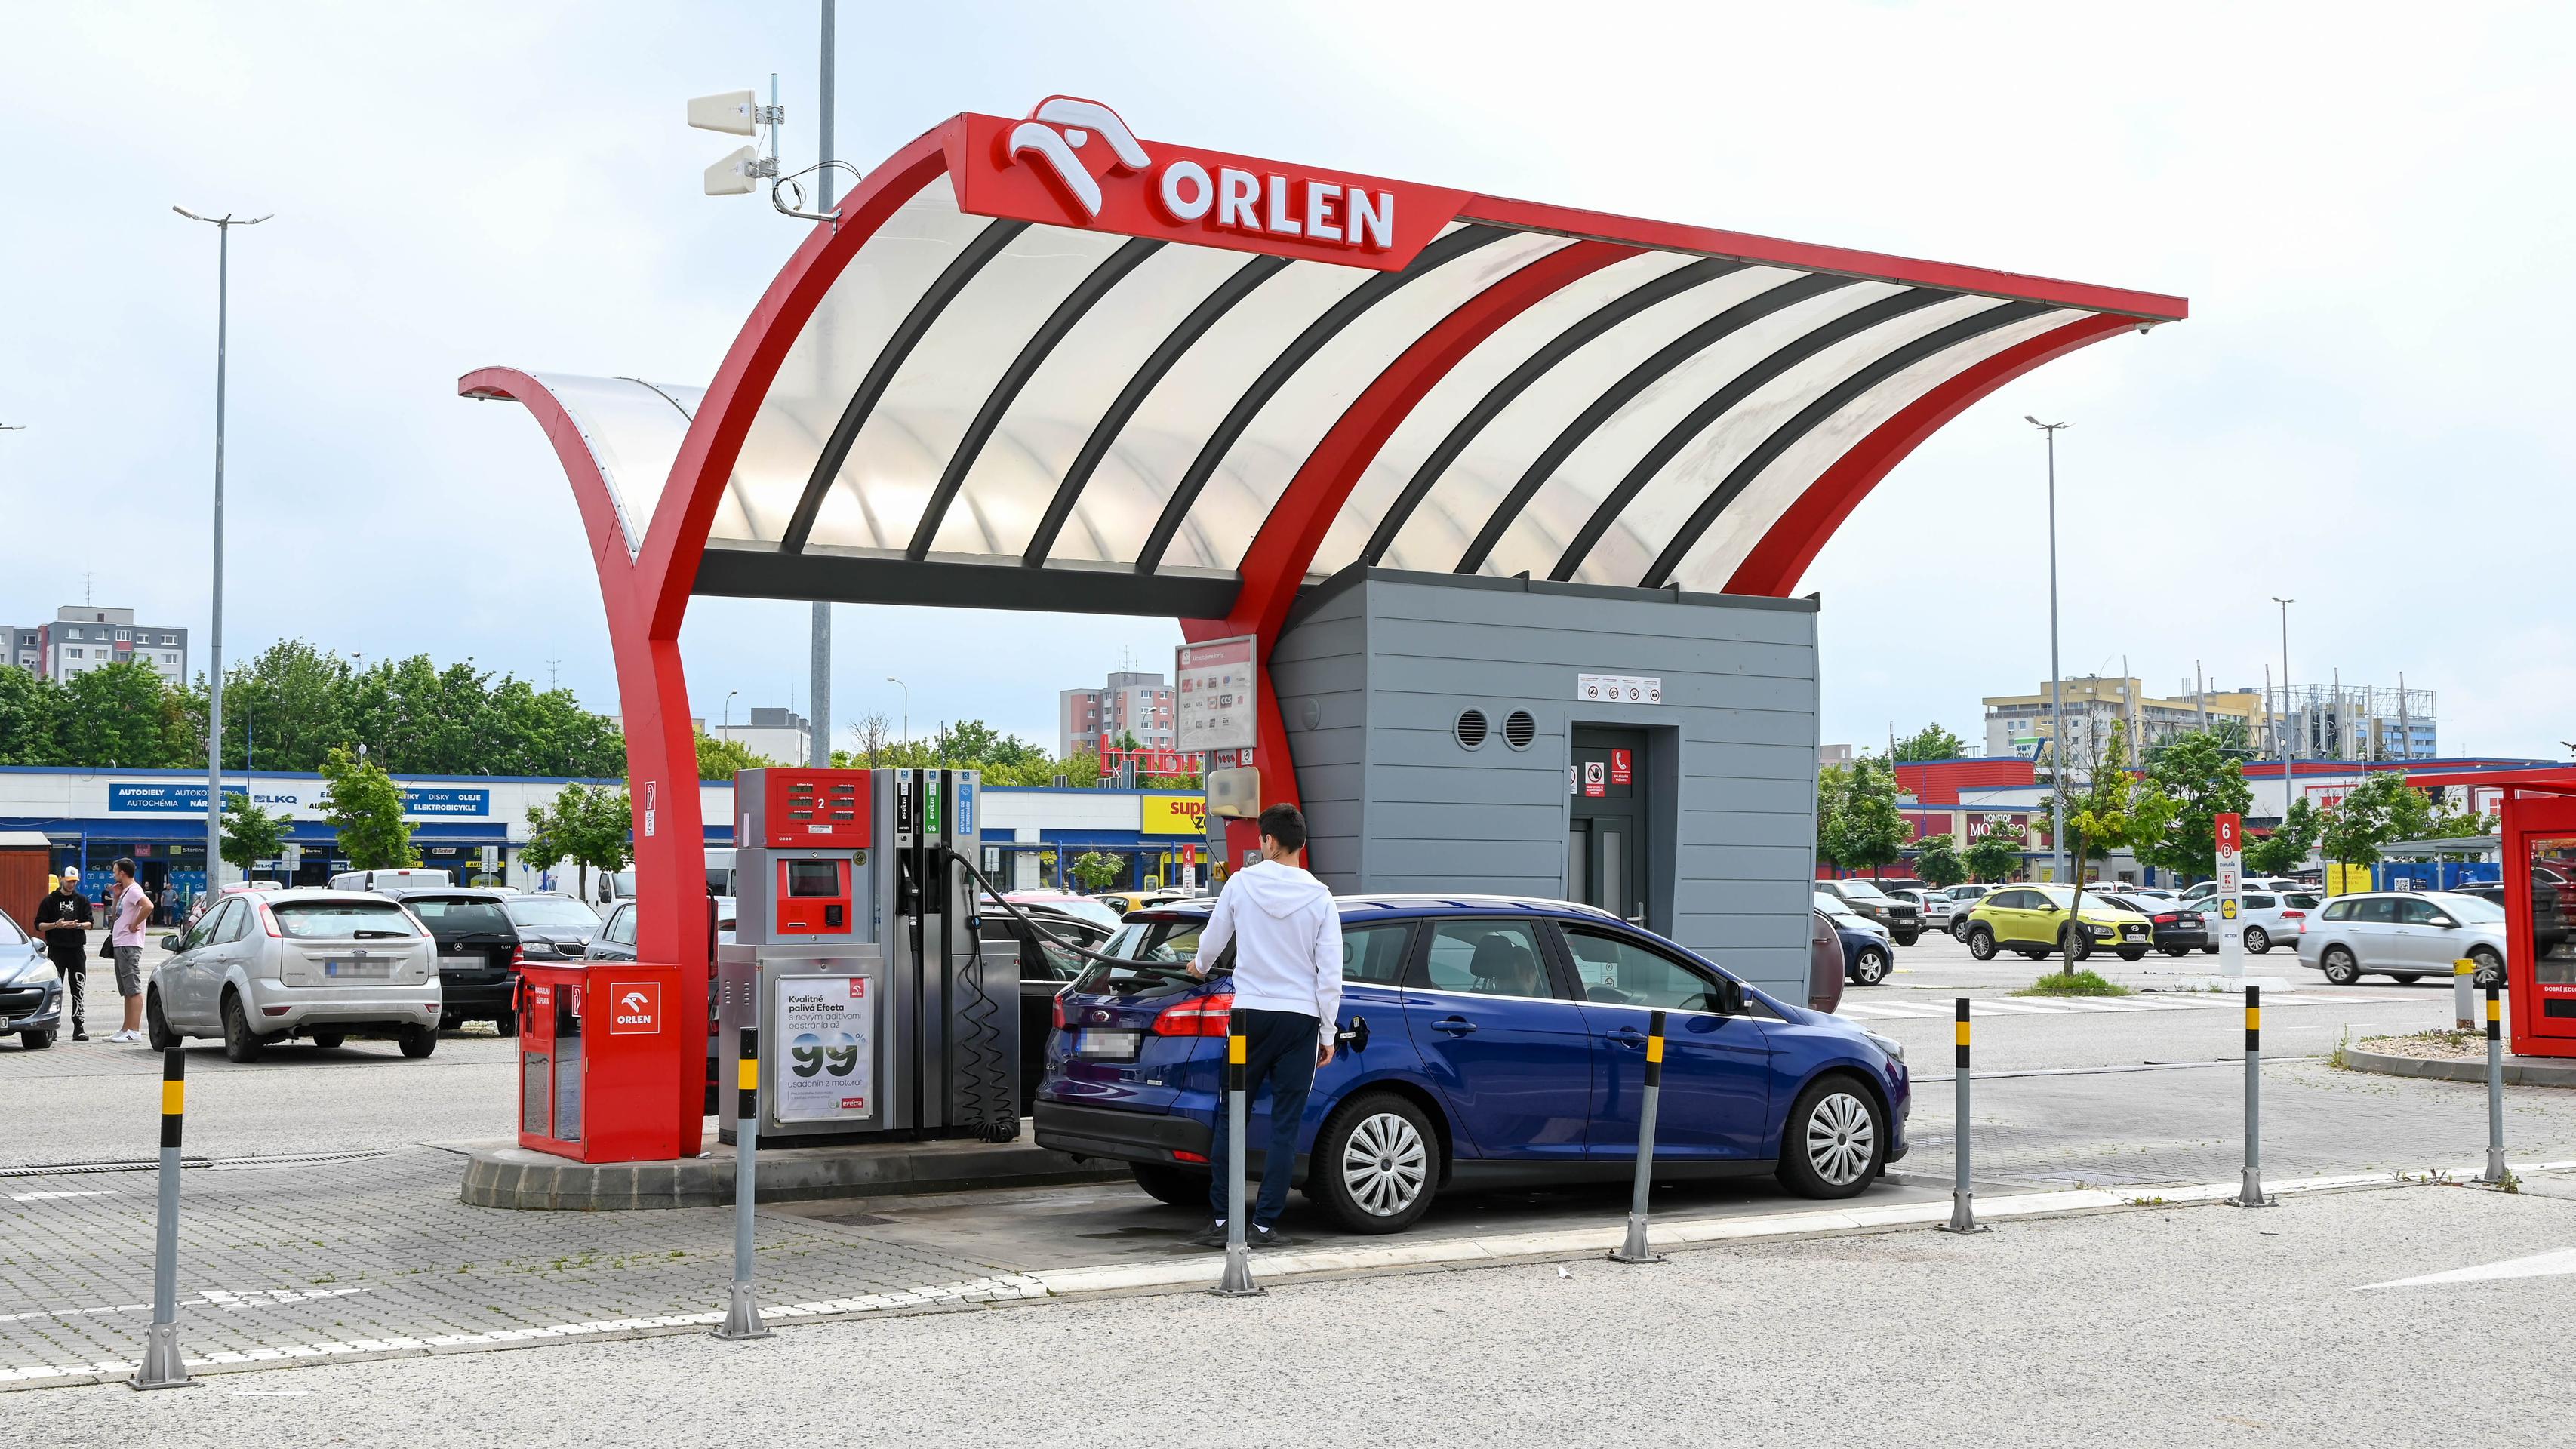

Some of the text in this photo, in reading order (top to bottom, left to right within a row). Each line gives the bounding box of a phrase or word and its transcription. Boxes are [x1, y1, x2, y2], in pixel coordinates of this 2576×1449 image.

[1160, 159, 1395, 249] ORLEN
[1220, 696, 1232, 704] CCS
[127, 798, 226, 808] AUTOCHÉMIA NÁRAIE
[266, 795, 297, 804] LKQ
[817, 798, 825, 809] 2
[1983, 814, 2012, 823] NONSTOP
[2221, 823, 2230, 840] 6
[1186, 850, 1190, 860] 4
[2224, 845, 2230, 857] B
[789, 995, 823, 1003] Kvalitné
[789, 1004, 815, 1013] palivá
[617, 1015, 651, 1024] ORLEN
[796, 1013, 824, 1021] novými
[826, 1012, 861, 1020] aditívami
[788, 1079, 823, 1088] usadenín
